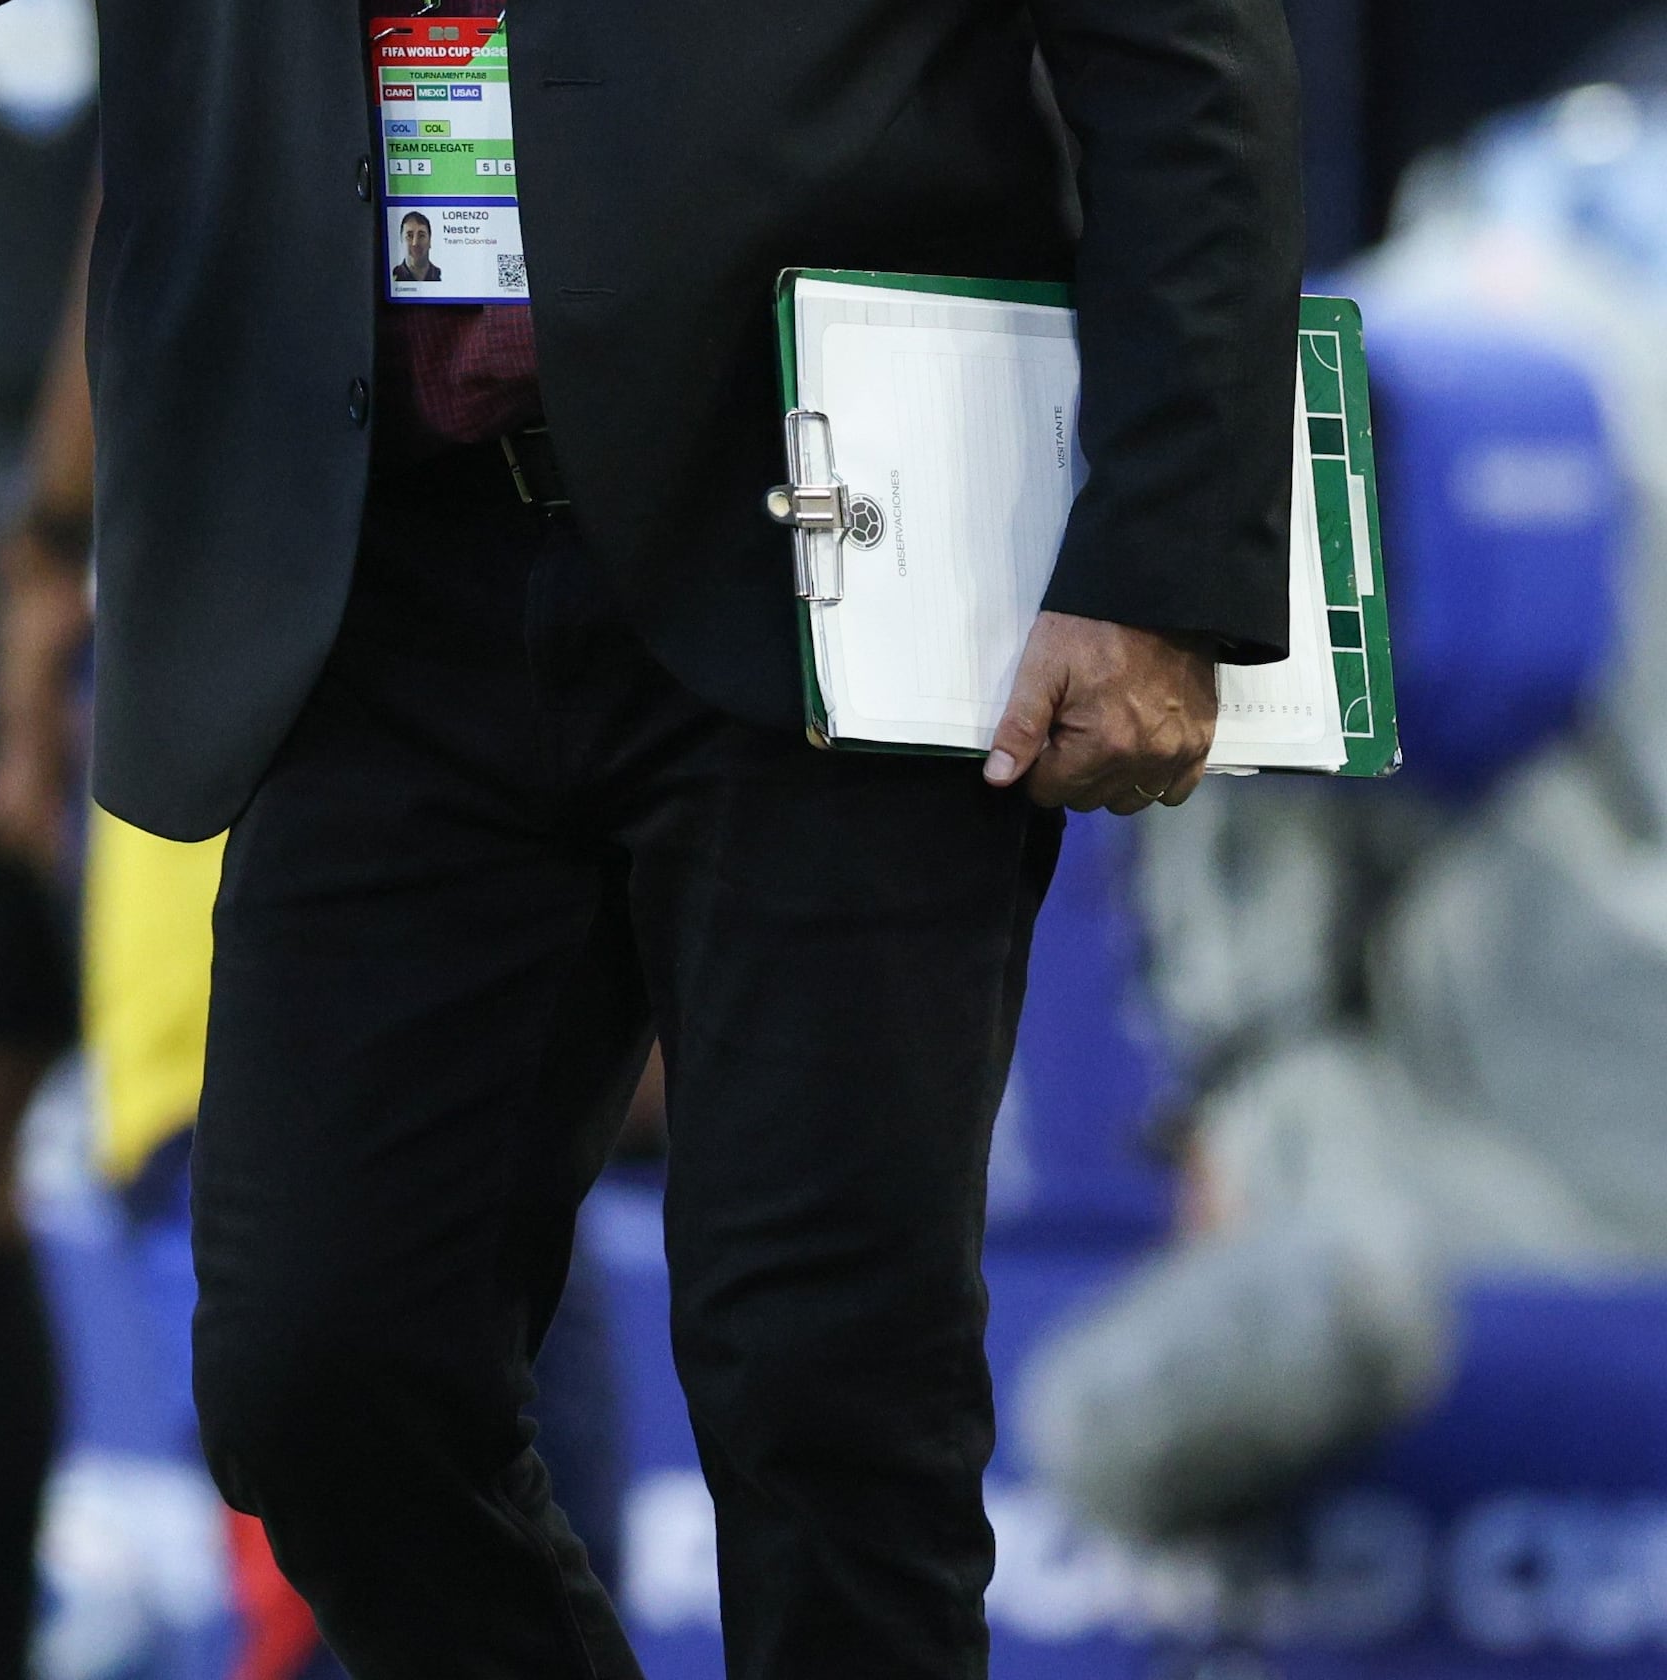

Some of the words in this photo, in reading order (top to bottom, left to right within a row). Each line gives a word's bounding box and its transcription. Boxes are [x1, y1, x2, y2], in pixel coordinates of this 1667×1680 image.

[382, 47, 406, 57] FIFA
[407, 47, 446, 57] WORLD
[448, 47, 470, 57] CUP
[425, 124, 444, 132] COL
[389, 144, 419, 152] TEAM
[421, 144, 474, 152] DELEGATE
[396, 163, 402, 171] 1
[418, 163, 425, 171] 2
[482, 163, 490, 172] 5
[504, 163, 512, 172] 6
[442, 211, 489, 220] LORENZO
[443, 225, 480, 233] Nestor
[1054, 406, 1065, 469] VISITANTE
[890, 470, 907, 577] OBSERVACIONES
